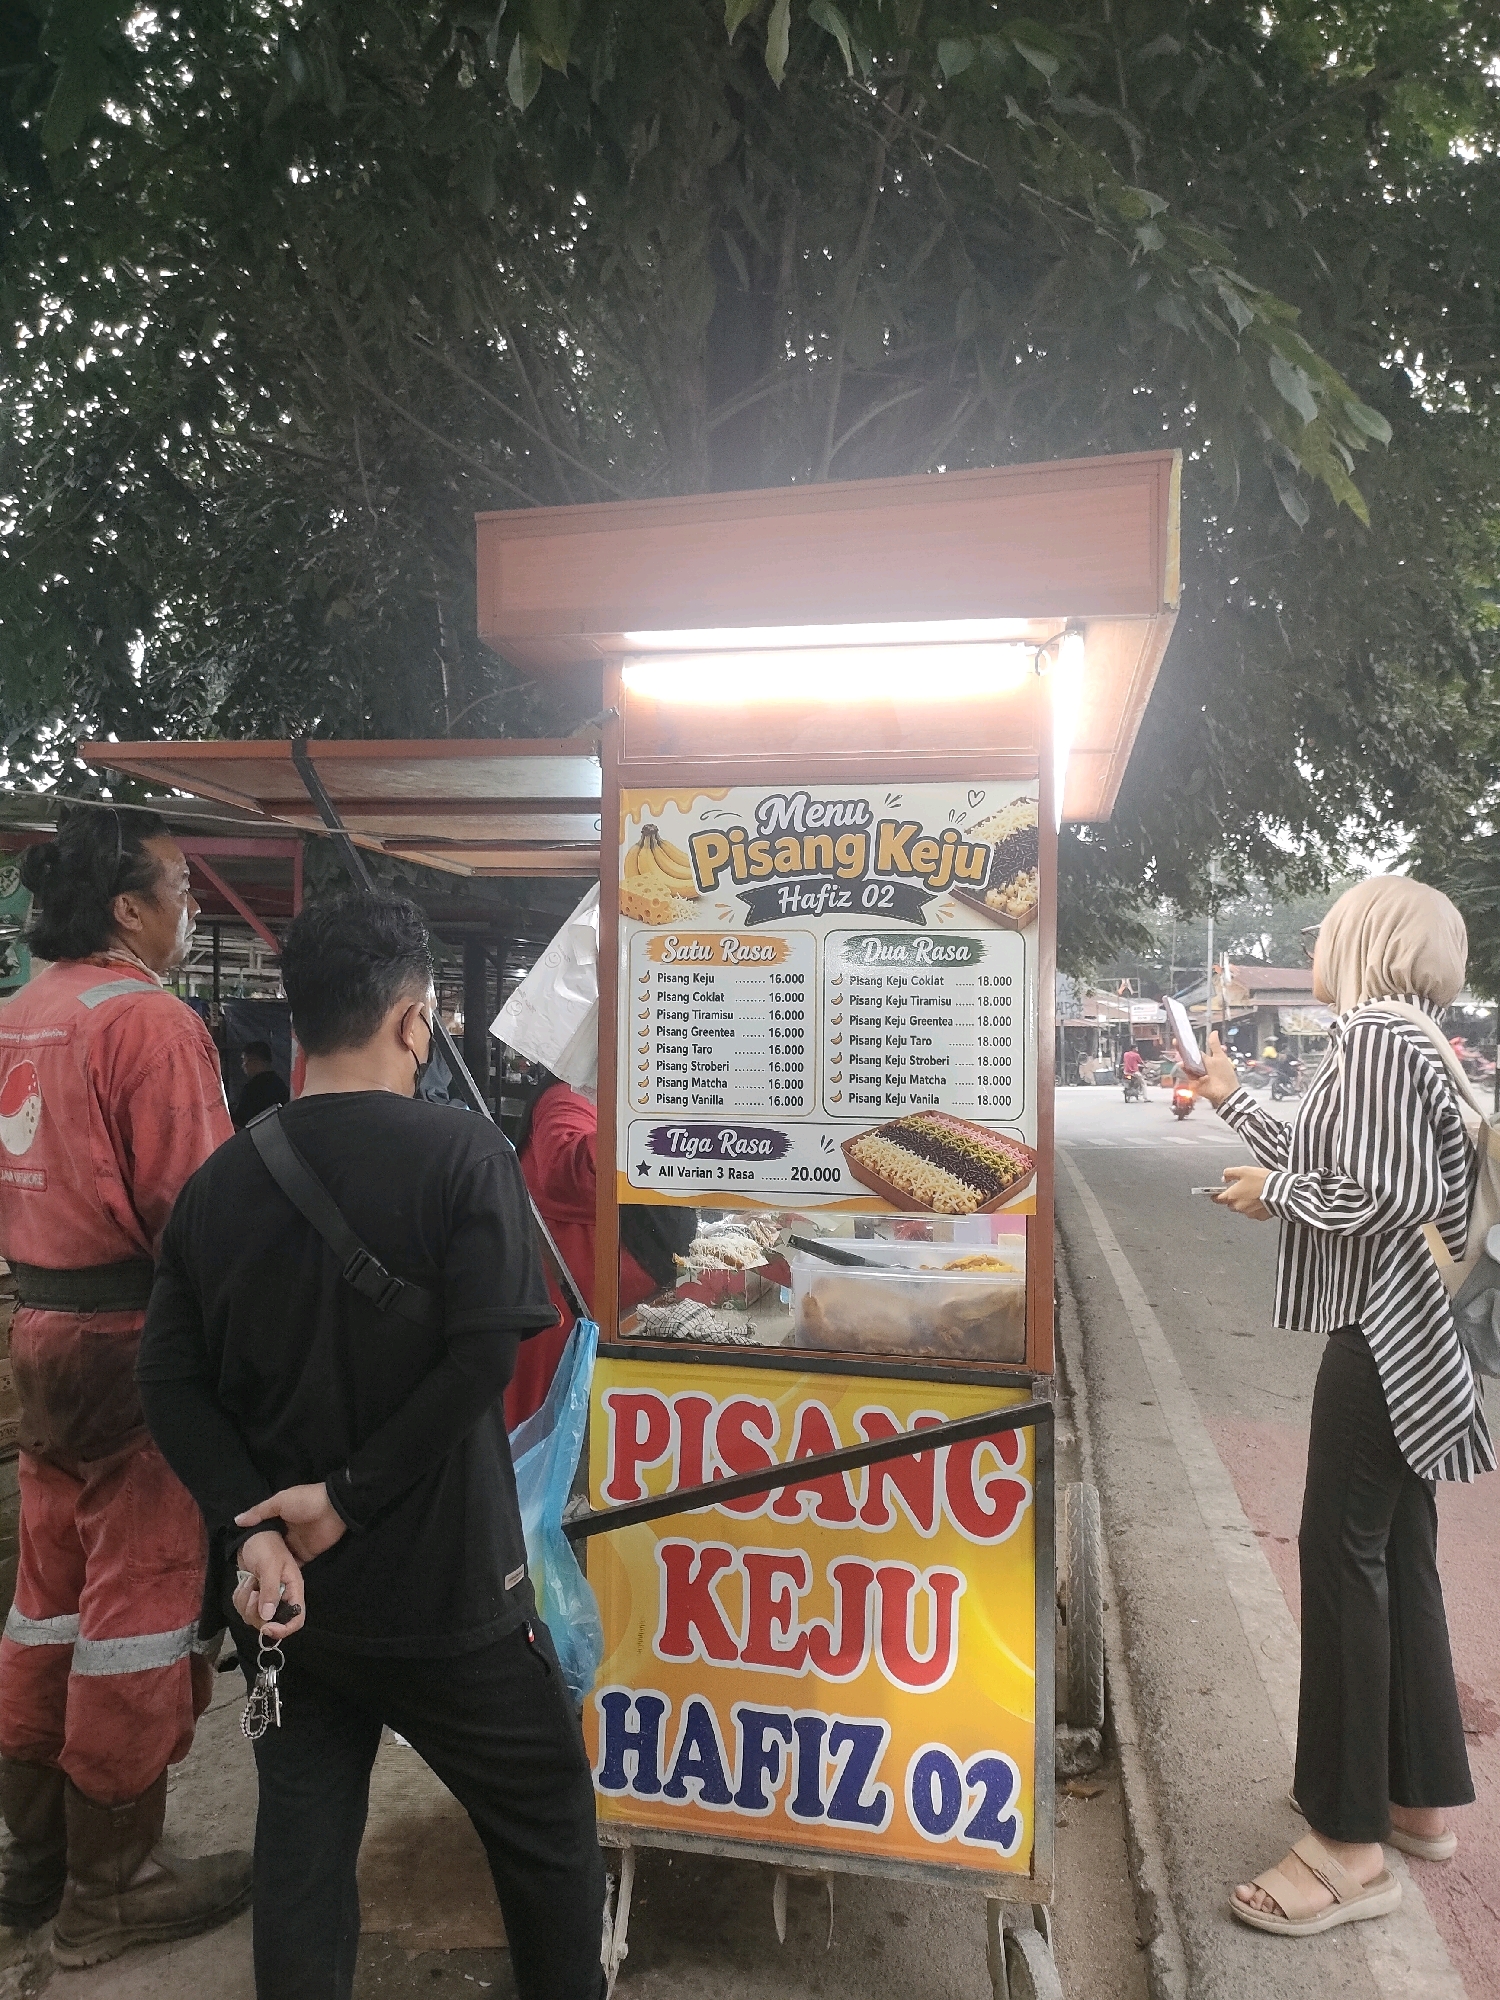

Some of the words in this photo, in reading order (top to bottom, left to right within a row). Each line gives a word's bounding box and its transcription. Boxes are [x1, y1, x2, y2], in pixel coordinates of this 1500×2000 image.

[758, 794, 870, 834] Menu
[692, 830, 866, 887] Pisang
[878, 823, 988, 887] Keju
[778, 884, 852, 914] Hafiz
[862, 884, 894, 908] 02
[661, 935, 714, 963] Satu
[720, 936, 777, 964] Rasa
[862, 937, 909, 963] Dua
[913, 937, 972, 964] Rasa
[657, 973, 690, 985] Pisang
[693, 973, 714, 986] Keju
[769, 974, 804, 984] 16.000
[850, 975, 882, 988] Pisang
[886, 976, 908, 988] Keju
[911, 975, 944, 986] Coklat
[977, 976, 1012, 986] 18.000
[657, 992, 690, 1003] Pisang
[693, 992, 725, 1002] Coklat
[769, 993, 804, 1002] 16.000
[850, 995, 882, 1008] Pisang
[886, 995, 907, 1008] Keju
[911, 996, 951, 1006] Tiramisu
[977, 997, 1012, 1006] 18.000
[657, 1009, 689, 1021] Pisang
[692, 1010, 733, 1020] Tiramisu
[769, 1010, 804, 1020] 16.000
[850, 1016, 882, 1028] Pisang
[885, 1016, 906, 1028] Keju
[910, 1016, 953, 1026] Greentea
[977, 1016, 1012, 1026] 18.000
[656, 1026, 688, 1039] Pisang
[691, 1027, 735, 1037] Greentea
[769, 1028, 804, 1038] 16.000
[850, 1035, 882, 1048] Pisang
[885, 1035, 907, 1048] Keju
[910, 1036, 932, 1045] Taro
[977, 1037, 1012, 1046] 18.000
[656, 1043, 688, 1056] Pisang
[692, 1044, 712, 1054] Taro
[769, 1045, 804, 1054] 16.000
[656, 1061, 688, 1073] Pisang
[691, 1061, 729, 1072] Stroberi
[769, 1062, 804, 1072] 16.000
[849, 1054, 881, 1067] Pisang
[885, 1054, 906, 1067] Keju
[910, 1055, 950, 1066] Stroberi
[977, 1057, 1011, 1066] 18.000
[656, 1077, 688, 1090] Pisang
[692, 1078, 728, 1088] Matcha
[769, 1079, 804, 1089] 16.000
[849, 1074, 881, 1087] Pisang
[885, 1074, 906, 1087] Keju
[910, 1074, 946, 1085] Matcha
[977, 1076, 1011, 1085] 18.000
[656, 1094, 688, 1107] Pisang
[692, 1094, 723, 1105] Vanilla
[769, 1096, 804, 1106] 16.000
[849, 1093, 881, 1106] Pisang
[885, 1093, 906, 1106] Keju
[910, 1094, 939, 1104] Vanila
[977, 1095, 1011, 1106] 18.000
[667, 1128, 713, 1159] Tiga
[718, 1129, 773, 1158] Rasa
[658, 1166, 673, 1177] All
[677, 1166, 713, 1178] Varian
[717, 1167, 724, 1178] 3
[728, 1167, 754, 1179] Rasa
[791, 1167, 841, 1182] 20.000
[605, 1392, 1027, 1539] PISANG
[658, 1543, 961, 1687] KEJU
[598, 1691, 888, 1827] HAFIZ
[911, 1749, 1018, 1850] 02
